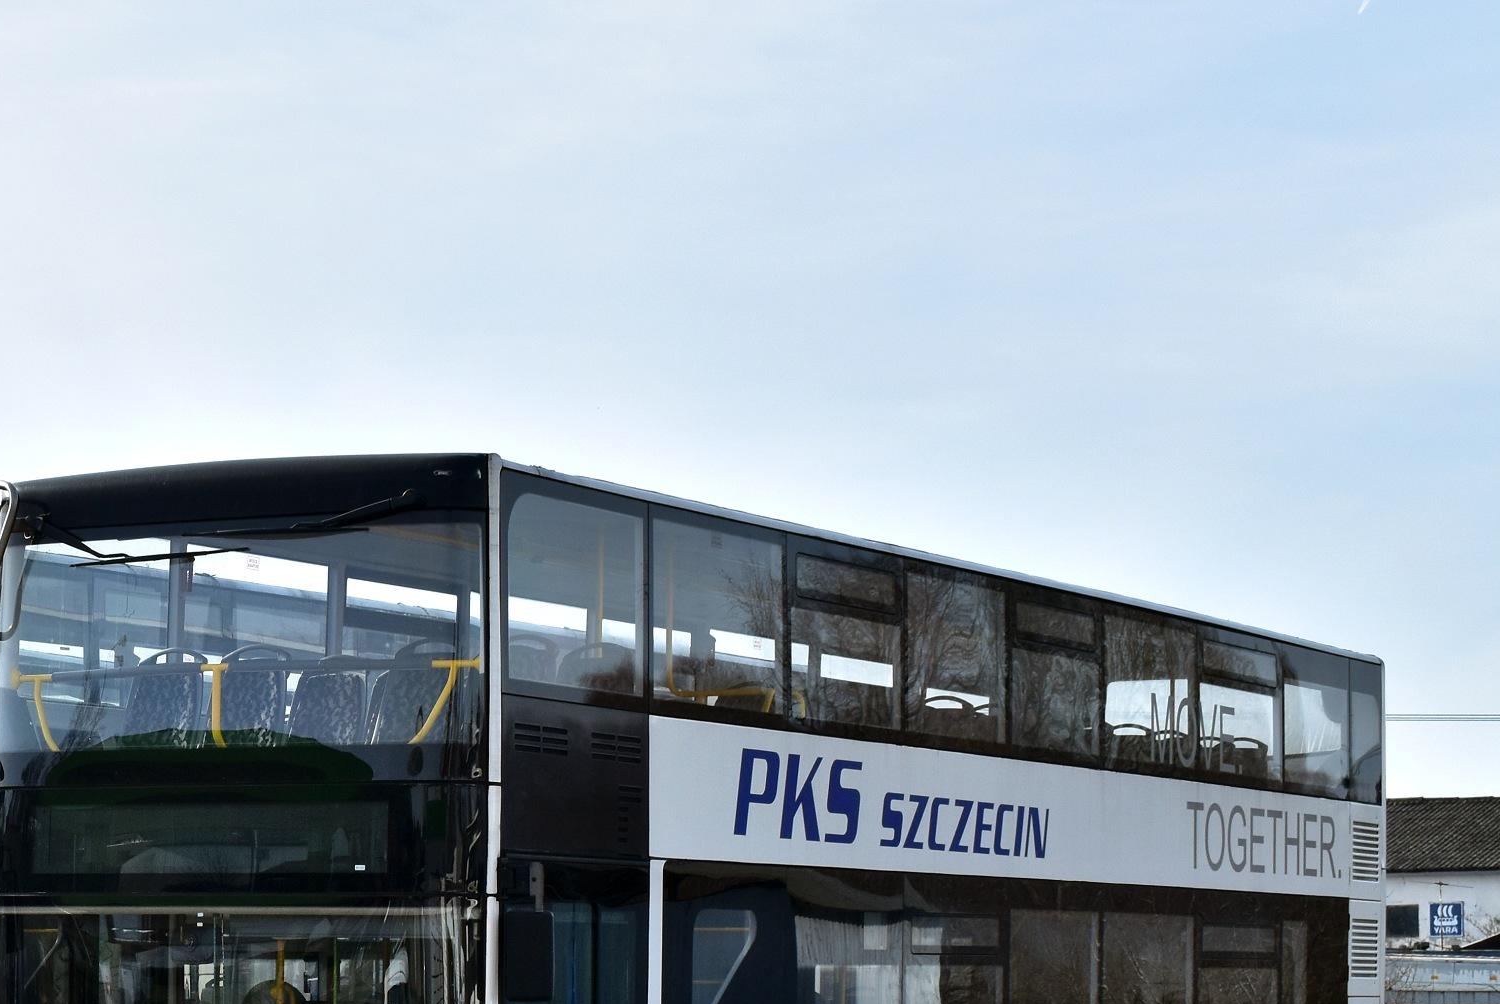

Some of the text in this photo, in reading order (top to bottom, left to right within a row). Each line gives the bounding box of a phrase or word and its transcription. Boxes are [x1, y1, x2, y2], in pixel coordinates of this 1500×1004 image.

[1150, 692, 1243, 774] MOVE.
[733, 747, 1049, 859] PKS SZCZECIN
[1186, 801, 1342, 879] TOGETHER.
[1433, 926, 1458, 934] YARA
